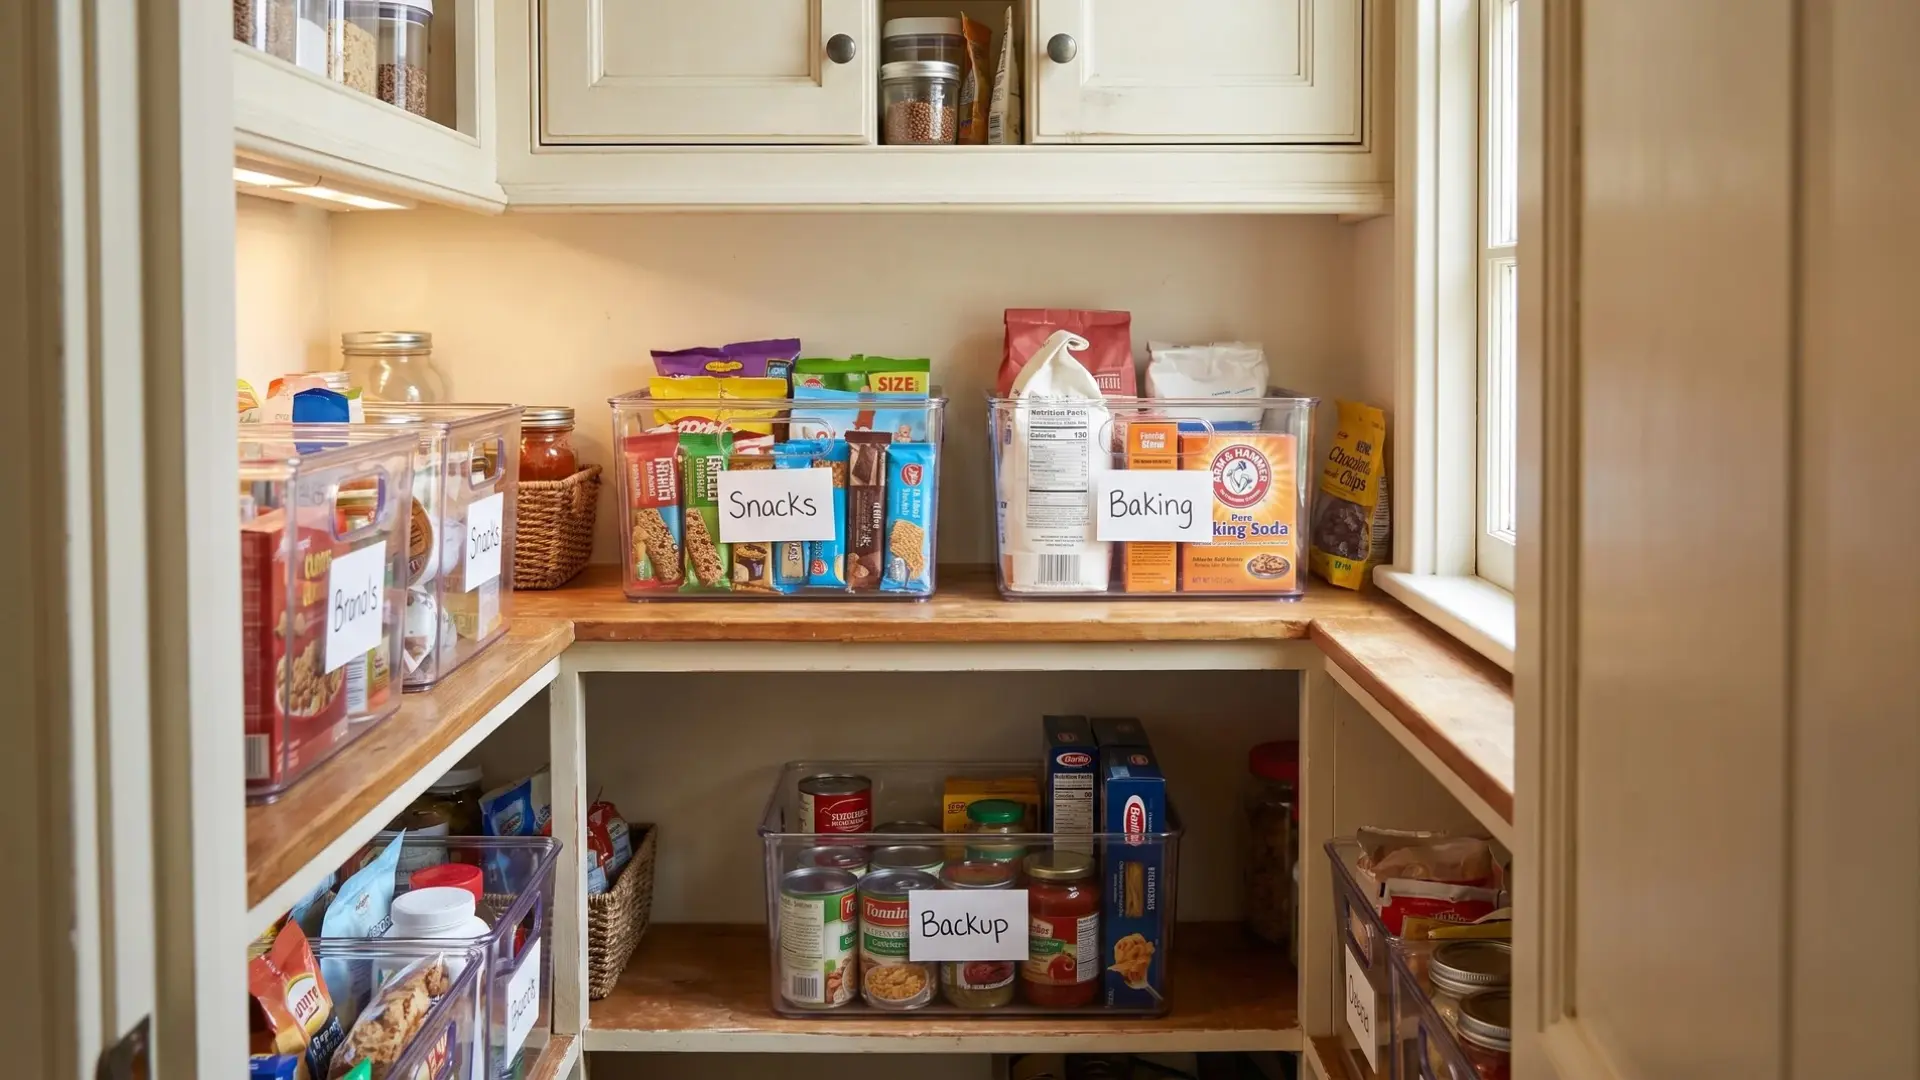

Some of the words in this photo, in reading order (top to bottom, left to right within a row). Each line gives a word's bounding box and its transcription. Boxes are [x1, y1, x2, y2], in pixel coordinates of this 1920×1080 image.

[878, 377, 914, 391] SIZE
[1213, 458, 1227, 482] ARM
[1224, 452, 1234, 461] &
[1235, 449, 1267, 482] HAMMER
[729, 490, 817, 518] Snacks
[1109, 489, 1193, 530] Baking
[470, 519, 500, 560] Snacks
[1213, 522, 1246, 539] king
[1251, 521, 1288, 535] Soda
[920, 910, 1009, 943] Backup
